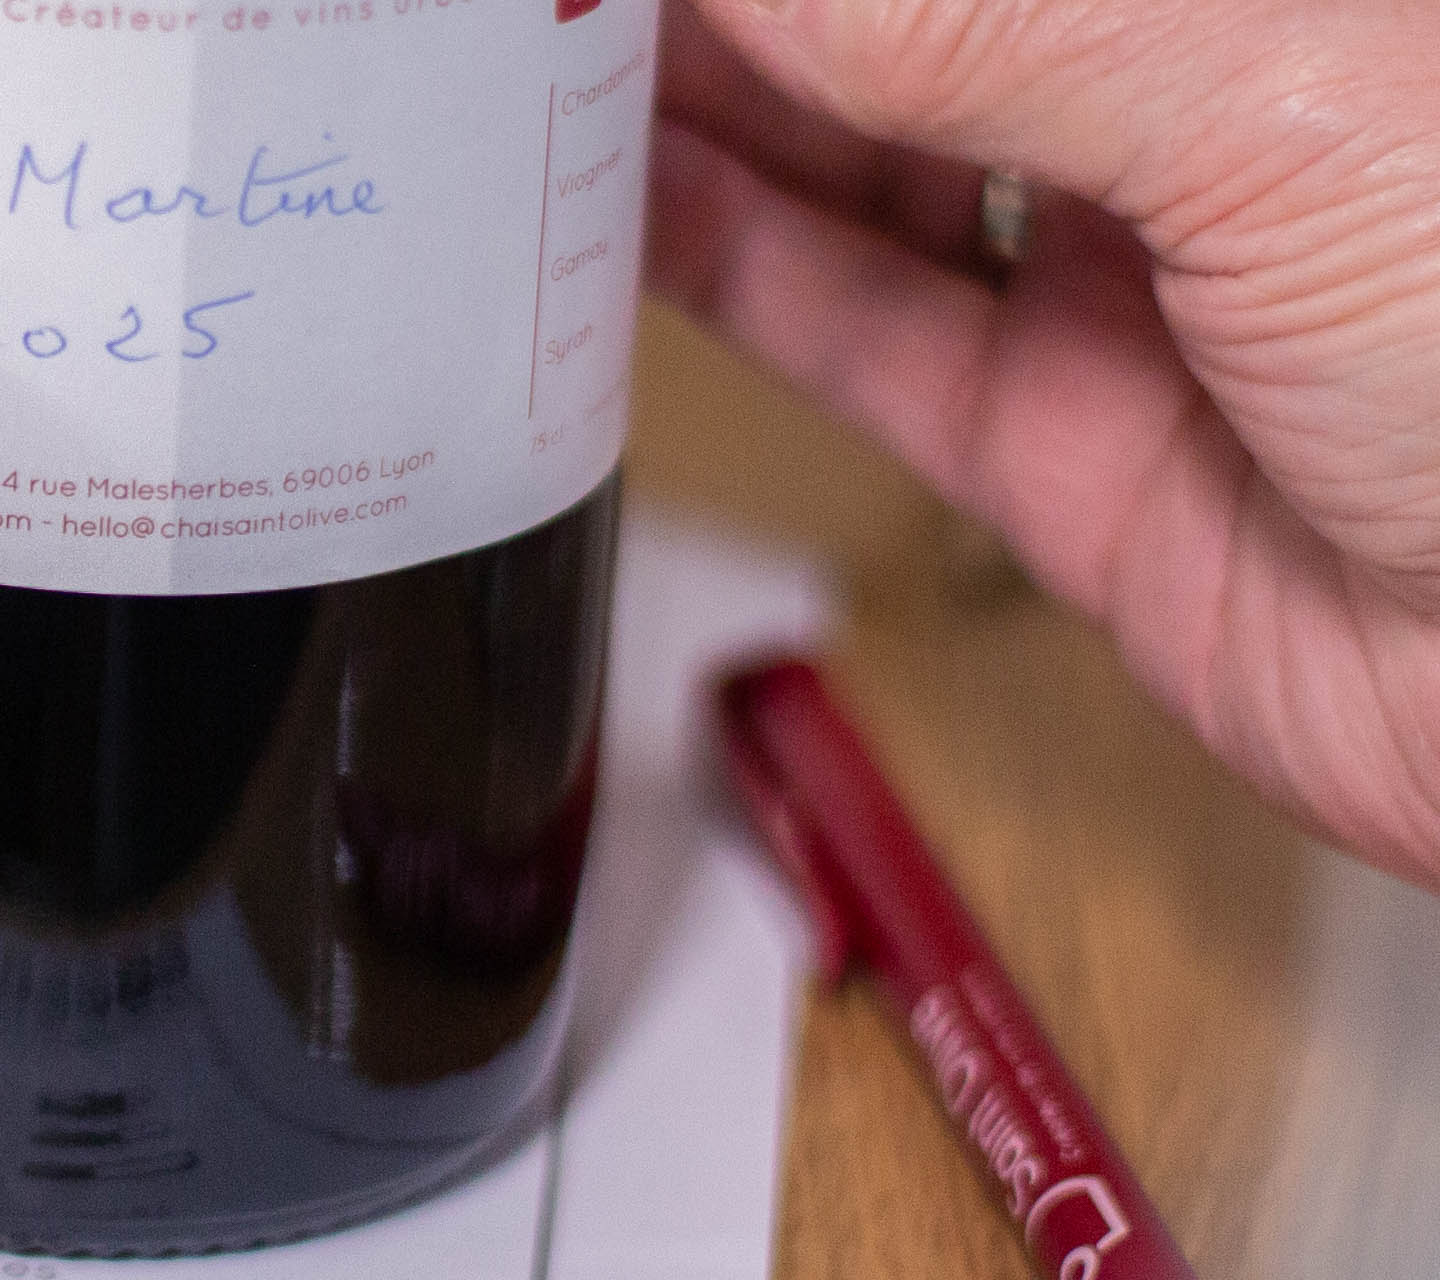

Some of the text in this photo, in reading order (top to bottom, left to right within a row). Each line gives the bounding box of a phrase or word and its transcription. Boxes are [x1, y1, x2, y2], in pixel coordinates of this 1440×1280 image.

[222, 1, 272, 32] de
[8, 130, 386, 230] Martine
[544, 320, 593, 365] Syrah
[29, 477, 77, 498] rue
[87, 476, 274, 502] Malesherbes,
[282, 460, 371, 495] 69006
[379, 448, 435, 481] Lyon
[61, 494, 408, 539] hello@chaisaintolive.com
